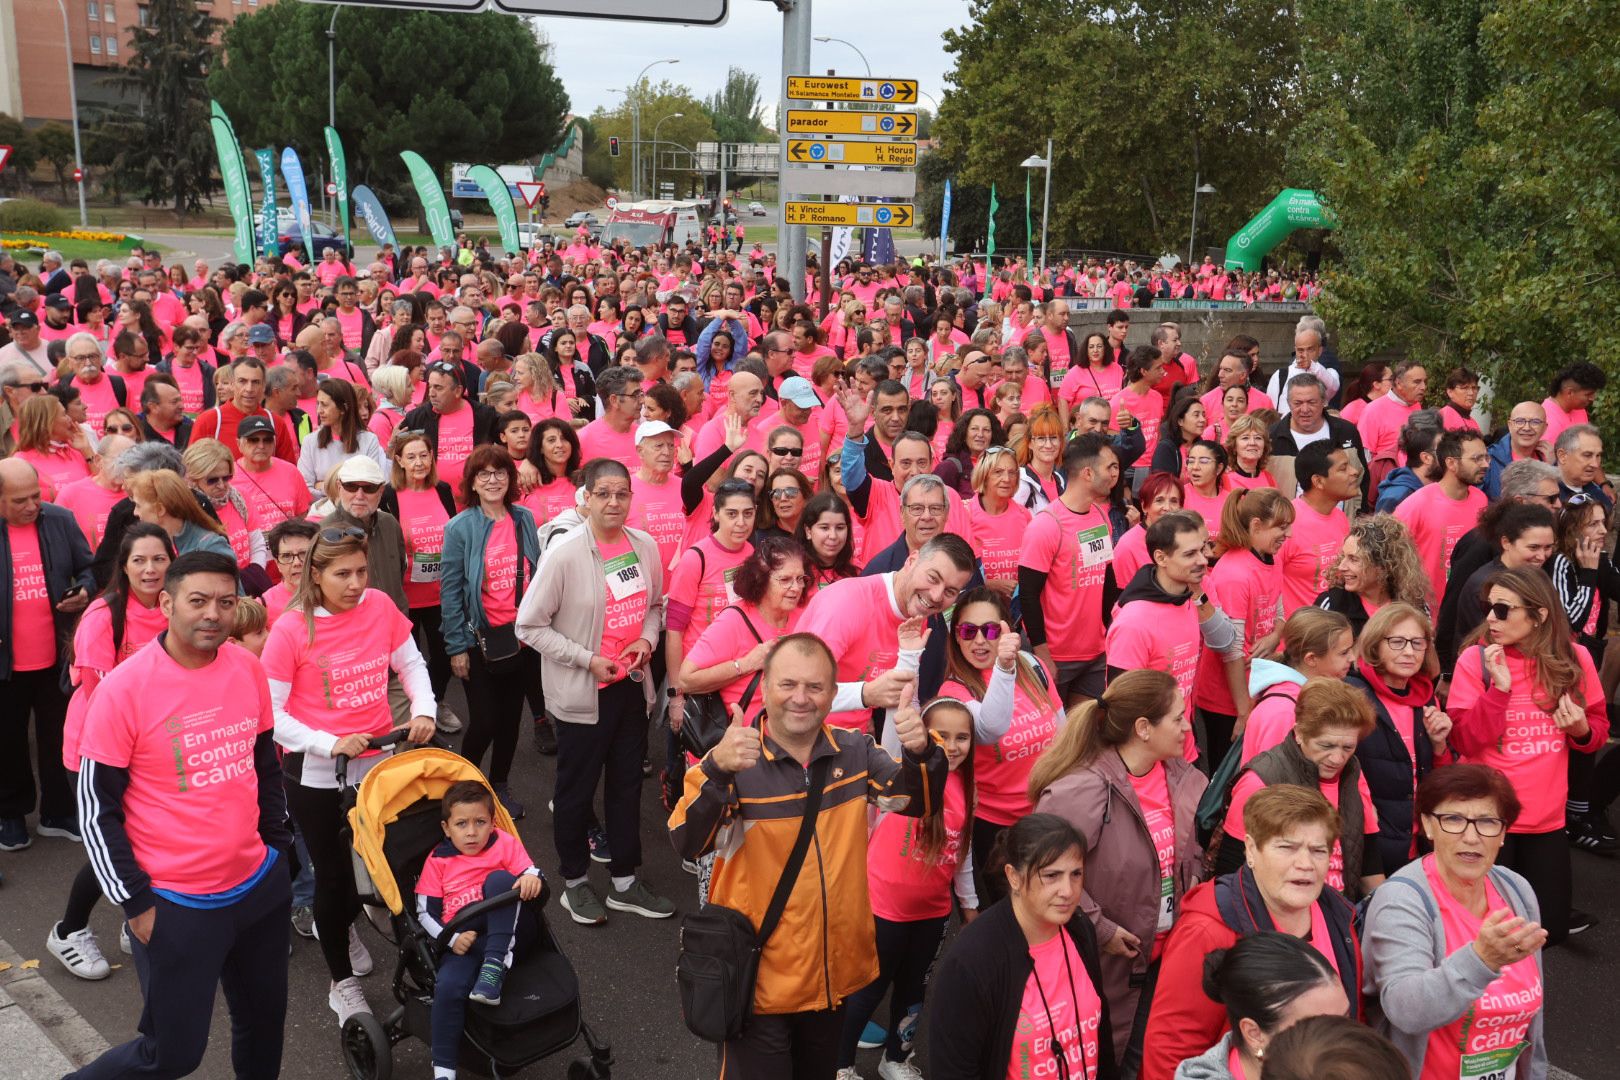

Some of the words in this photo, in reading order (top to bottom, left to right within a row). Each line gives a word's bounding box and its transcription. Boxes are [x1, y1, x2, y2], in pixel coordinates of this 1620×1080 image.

[804, 80, 848, 89] Eurowest
[790, 118, 828, 127] parador
[889, 155, 913, 164] Regio
[437, 452, 469, 460] cánc
[413, 534, 443, 544] contr
[1088, 539, 1104, 553] 7837
[415, 543, 443, 553] cán
[982, 549, 995, 558] En
[998, 549, 1020, 557] marc
[19, 564, 43, 573] mar
[488, 558, 500, 567] En
[489, 564, 517, 578] cont
[617, 566, 639, 583] 1896
[985, 570, 1018, 580] cánc
[1079, 573, 1105, 587] cánc
[16, 587, 48, 601] ánc
[606, 596, 643, 614] contra
[607, 609, 645, 629] cánc
[332, 669, 350, 680] En
[352, 652, 389, 675] march
[334, 672, 382, 694] contra
[1506, 710, 1526, 721] En
[184, 733, 206, 748] En
[211, 716, 258, 740] marcha
[1003, 722, 1052, 746] contra
[188, 740, 246, 766] contra
[1005, 738, 1053, 762] cánc
[1507, 738, 1563, 754] cánc
[192, 753, 254, 787] cánce
[1481, 993, 1502, 1010] En
[1476, 1010, 1534, 1028] contr
[1472, 1025, 1528, 1051] cánc
